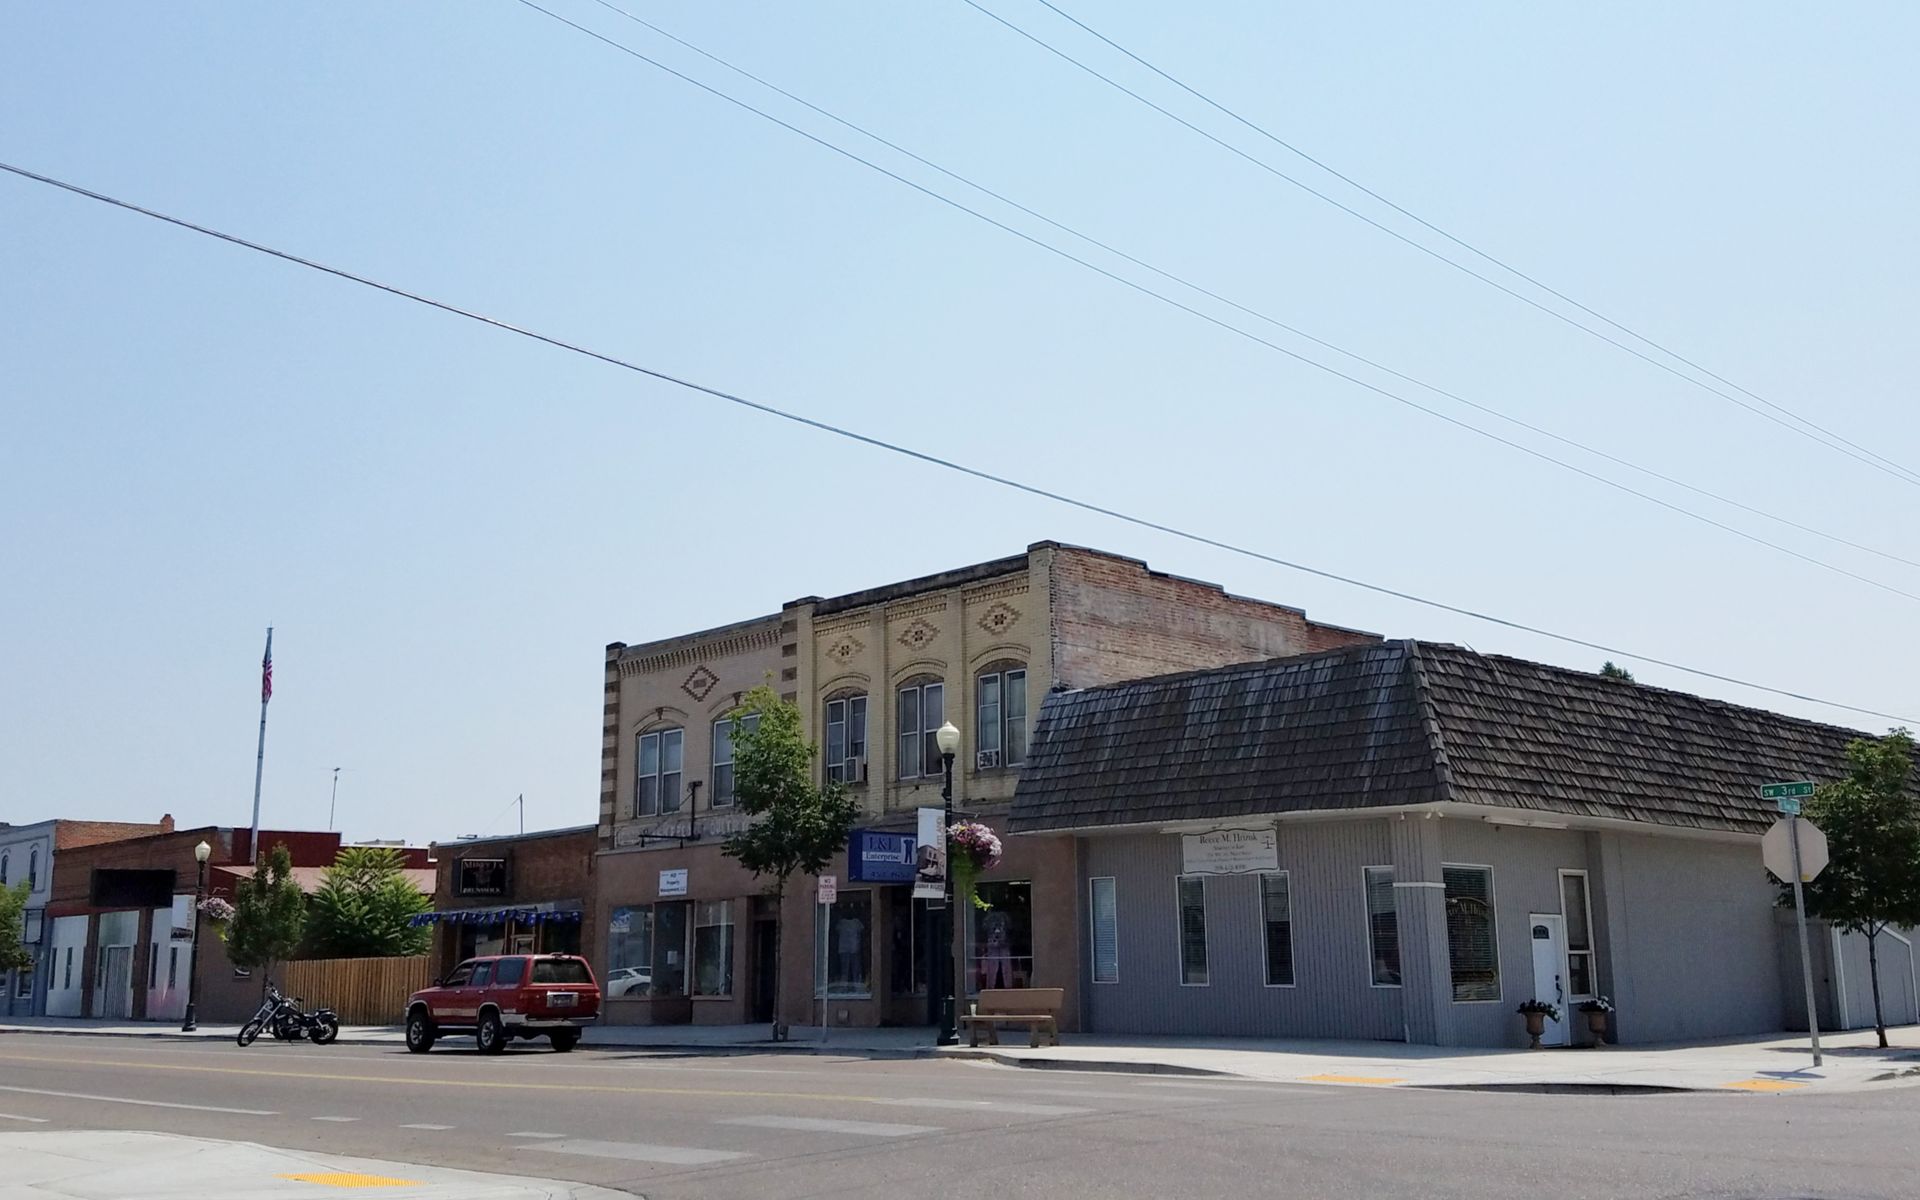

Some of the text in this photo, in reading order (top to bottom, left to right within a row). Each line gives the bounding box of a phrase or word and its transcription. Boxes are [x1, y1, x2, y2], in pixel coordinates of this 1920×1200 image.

[1763, 785, 1812, 797] SW 3rd St
[865, 852, 901, 861] Enterprise
